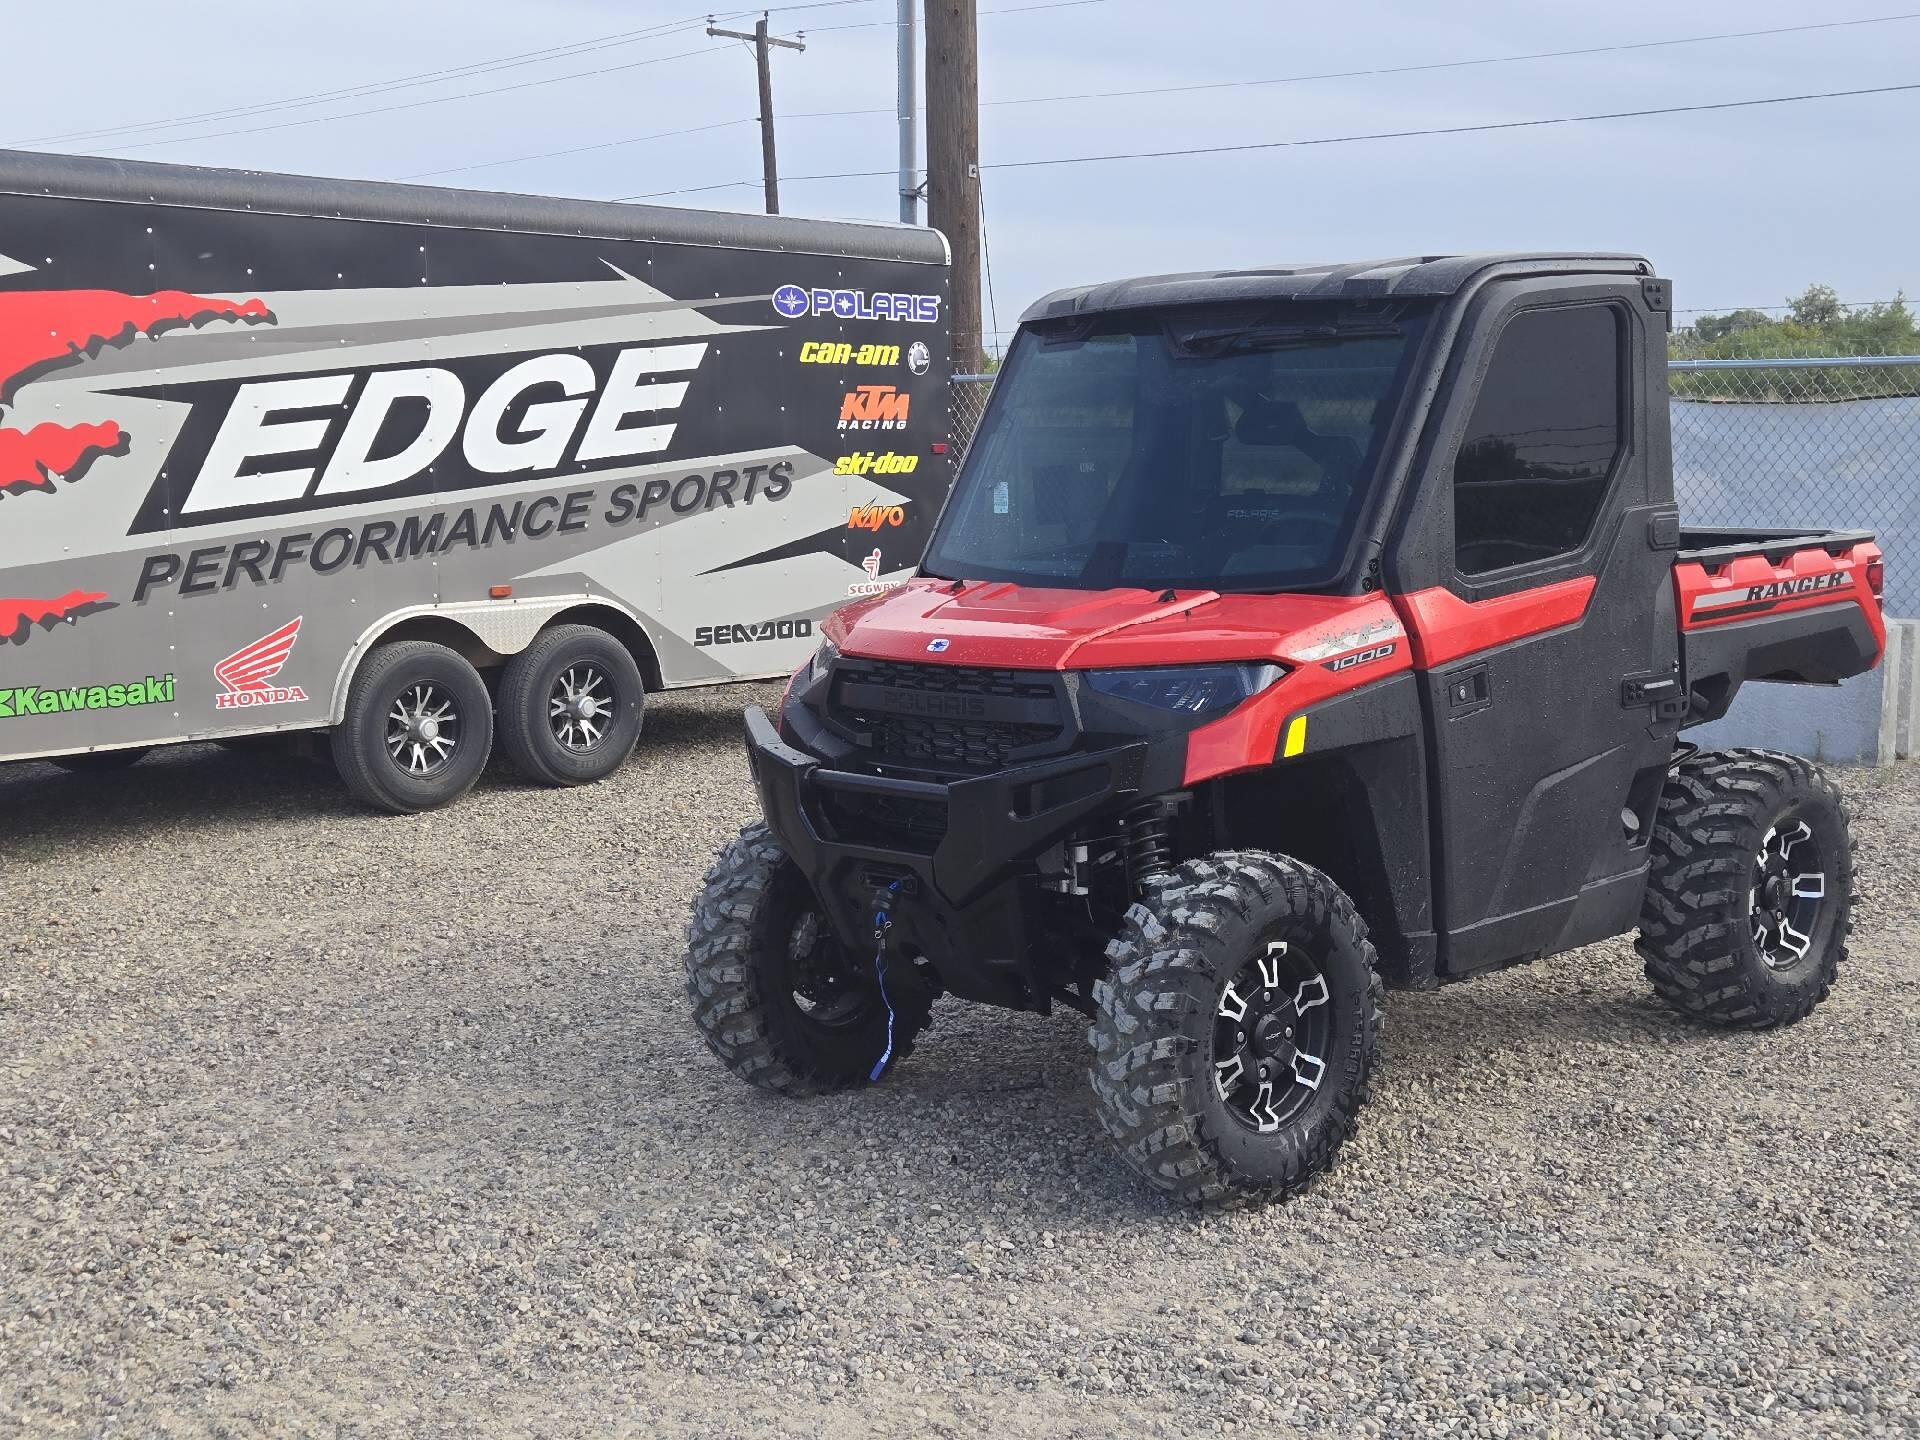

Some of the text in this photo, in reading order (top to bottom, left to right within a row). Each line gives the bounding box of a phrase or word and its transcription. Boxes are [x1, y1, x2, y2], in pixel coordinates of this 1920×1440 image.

[812, 288, 940, 322] POLARIS
[800, 342, 900, 365] can-am
[839, 385, 910, 420] KTM
[180, 342, 709, 514] EDGE
[837, 420, 907, 430] RACING
[833, 451, 918, 475] ski-doo
[848, 499, 905, 531] KAYO
[132, 461, 796, 603] PERFORMANCE SPORTS
[848, 582, 899, 595] SEGWAY
[1746, 571, 1844, 602] RANGER
[1333, 644, 1393, 671] 1000
[14, 673, 175, 716] Kawasaki
[216, 686, 308, 709] HONDA
[884, 690, 985, 716] POLARIS
